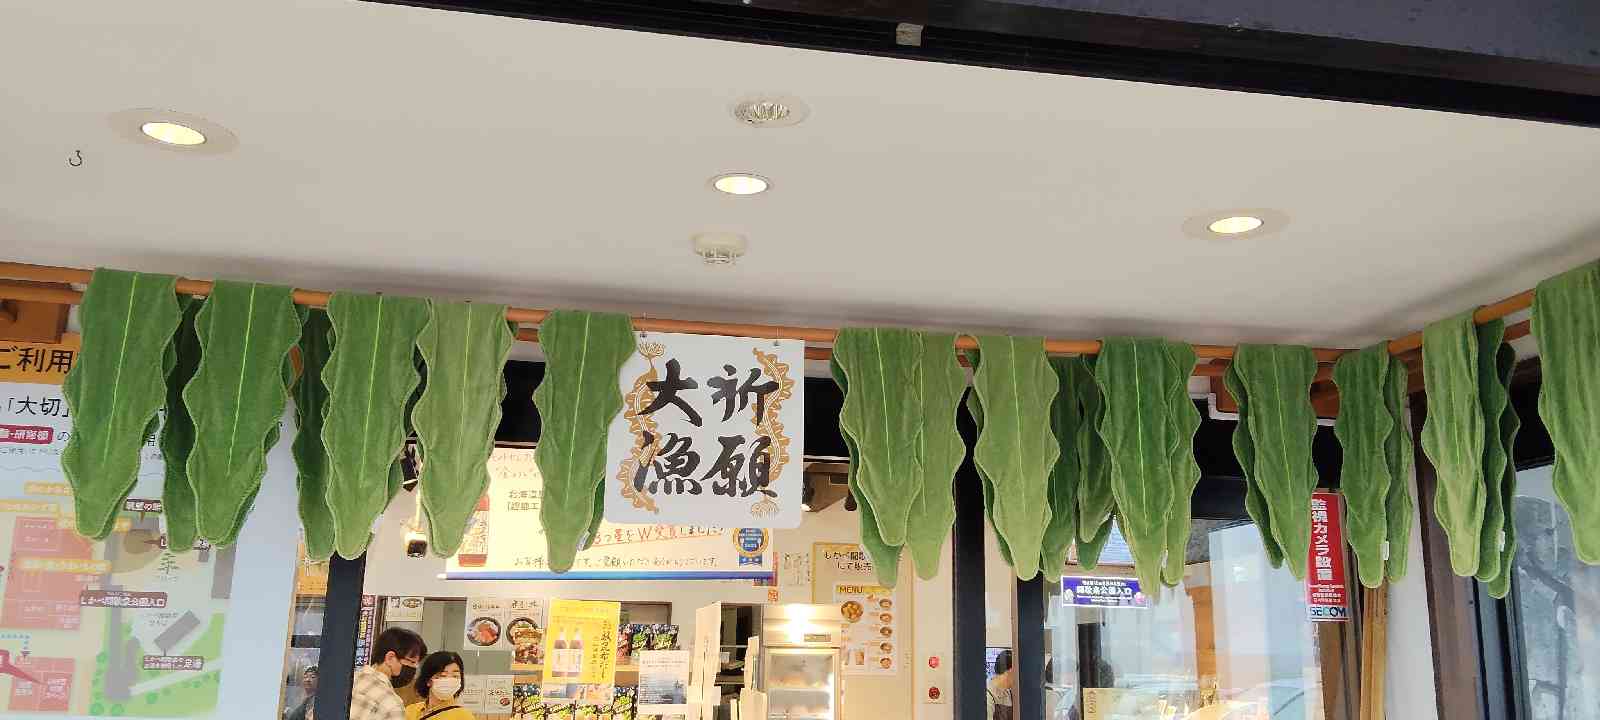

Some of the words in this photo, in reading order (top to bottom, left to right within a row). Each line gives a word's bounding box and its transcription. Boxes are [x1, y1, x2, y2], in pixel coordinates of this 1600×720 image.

[1312, 498, 1333, 581] 監視カメラ設置
[839, 585, 863, 593] MENU
[1310, 606, 1346, 618] SECOM
